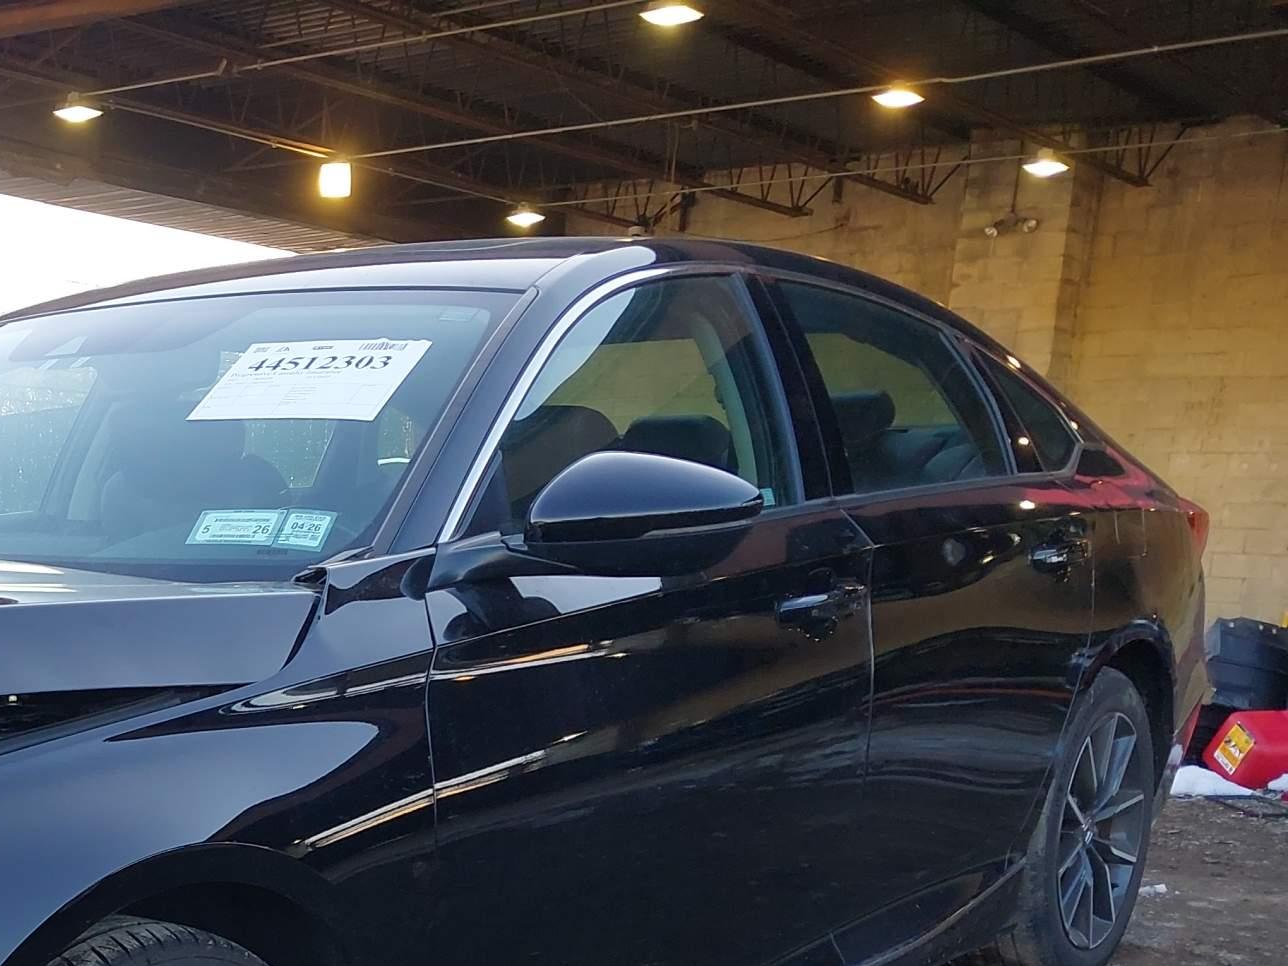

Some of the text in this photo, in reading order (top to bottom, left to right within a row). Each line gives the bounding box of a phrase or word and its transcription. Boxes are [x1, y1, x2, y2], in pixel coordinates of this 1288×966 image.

[248, 355, 392, 371] 44512303
[202, 525, 212, 534] 5
[253, 525, 270, 534] 26
